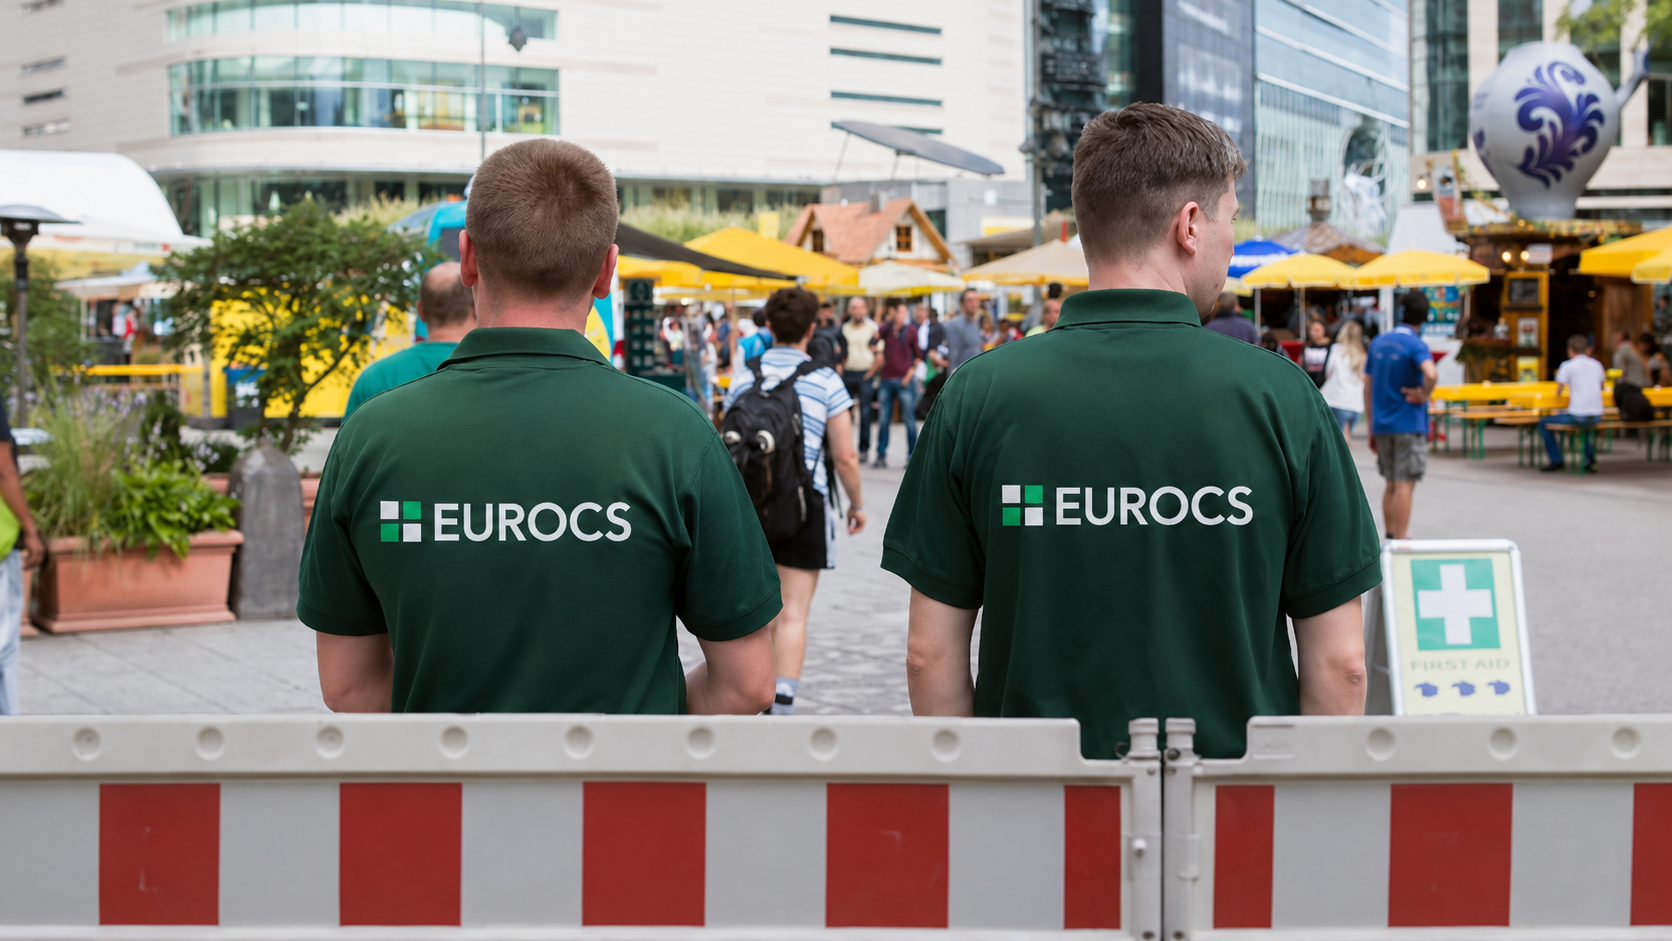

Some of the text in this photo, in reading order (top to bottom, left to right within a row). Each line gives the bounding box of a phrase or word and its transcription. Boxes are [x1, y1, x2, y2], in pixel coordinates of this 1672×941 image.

[434, 502, 632, 542] EUROCS
[1056, 486, 1254, 526] EUROCS
[1410, 658, 1510, 672] FIRST AID
